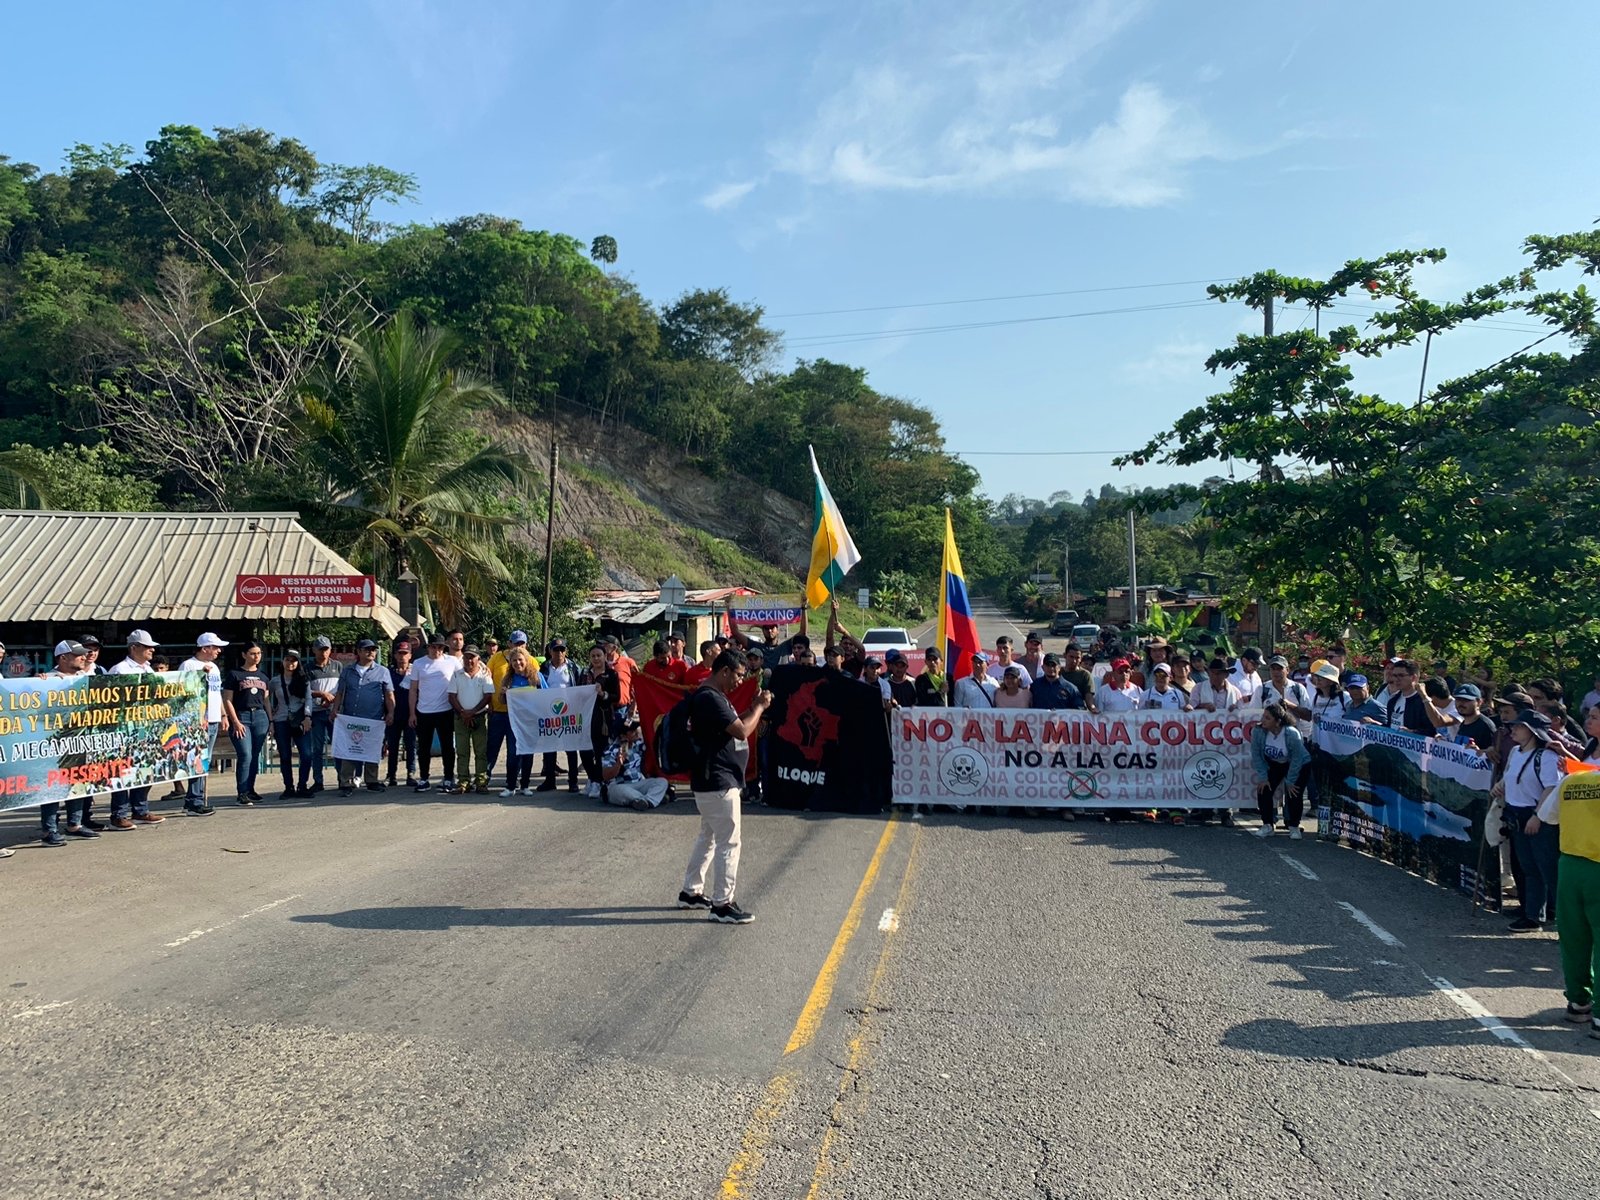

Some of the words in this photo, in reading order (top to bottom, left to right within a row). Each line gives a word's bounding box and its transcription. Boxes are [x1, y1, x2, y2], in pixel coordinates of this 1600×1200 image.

[267, 586, 285, 594] LAS
[288, 586, 312, 594] TRES
[314, 586, 361, 594] ESQUINAS
[288, 595, 306, 603] LOS
[309, 595, 341, 603] PAISAS
[745, 598, 763, 608] NO
[734, 609, 795, 621] FRACKING
[10, 690, 42, 711] LOS
[124, 685, 134, 702] Y
[136, 684, 151, 701] EL
[28, 714, 39, 732] Y
[43, 712, 64, 731] LA
[68, 707, 121, 729] MADRE
[538, 712, 583, 729] COLOMBIA
[903, 719, 953, 743] NO
[961, 719, 985, 743] A
[994, 720, 1033, 744] LA
[1042, 720, 1132, 746] MINA
[1319, 720, 1362, 738] COMPROMISO
[1361, 728, 1379, 741] PARA
[1378, 732, 1388, 743] LA
[1387, 733, 1416, 751] DEFENSA
[1416, 741, 1428, 755] DEL
[1428, 743, 1447, 759] AGUA
[1446, 747, 1452, 761] Y
[1005, 750, 1042, 768] NO
[1051, 751, 1068, 768] A
[1076, 751, 1105, 769] LA
[1113, 752, 1158, 769] CAS
[777, 764, 826, 786] BLOQUE
